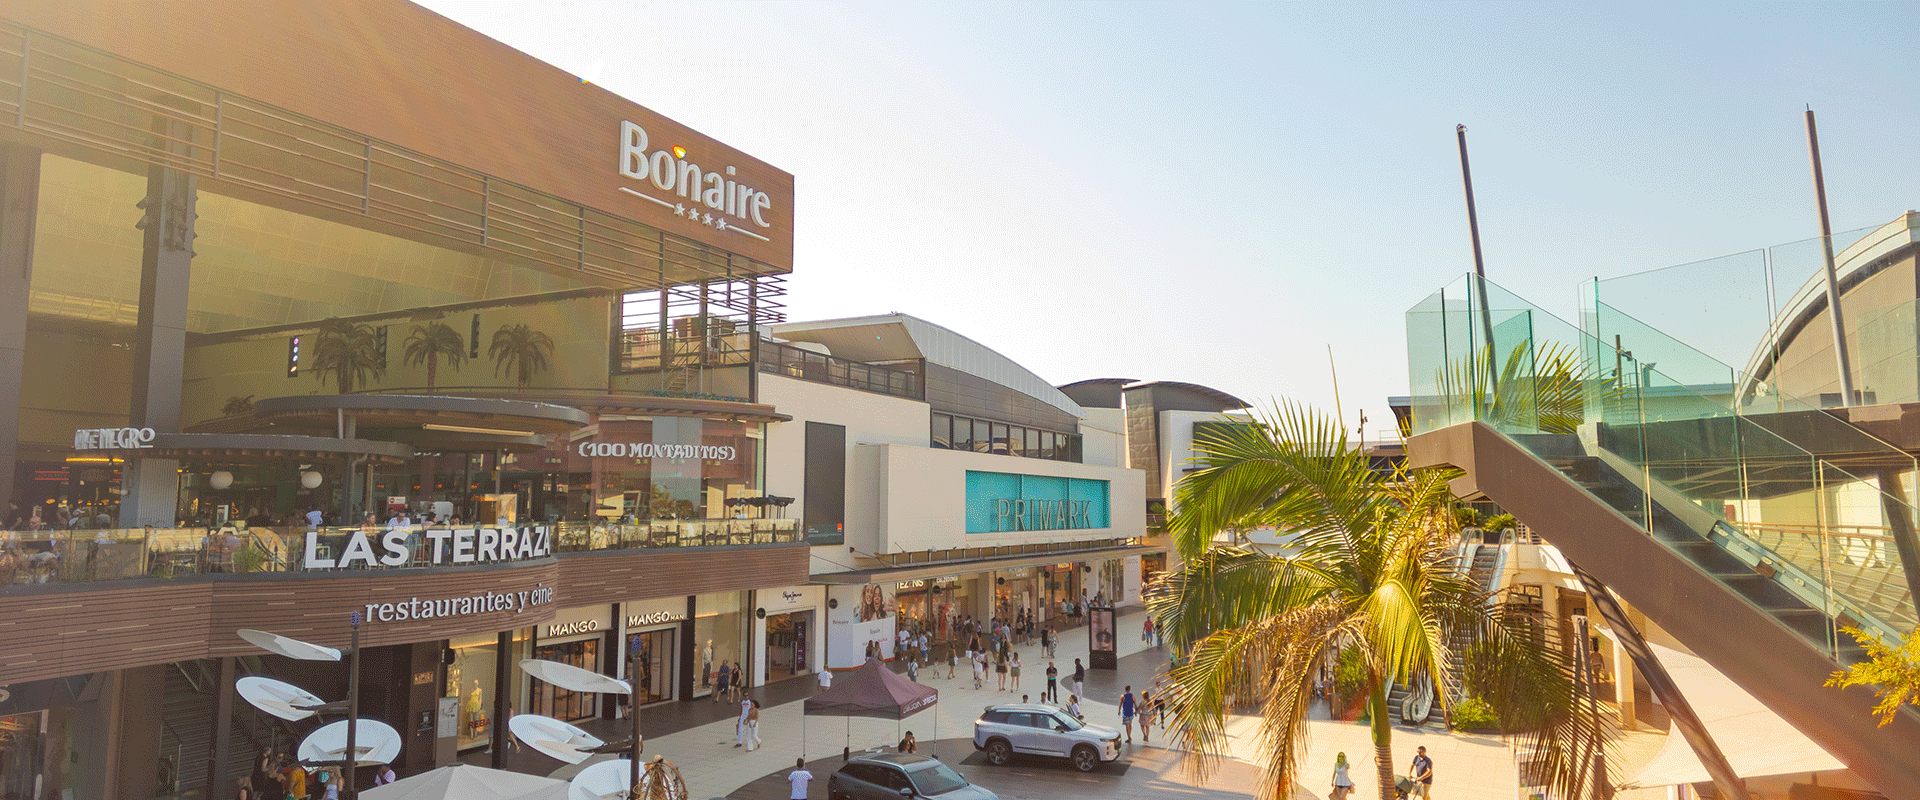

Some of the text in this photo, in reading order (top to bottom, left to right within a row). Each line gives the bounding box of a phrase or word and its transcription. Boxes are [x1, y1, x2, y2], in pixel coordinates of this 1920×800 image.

[618, 120, 771, 227] Bonaire
[997, 499, 1092, 532] PRIMARK
[305, 531, 410, 569] LAS
[365, 583, 553, 623] restaurantes y cine
[628, 611, 670, 627] MANGO
[549, 619, 598, 637] MANGO
